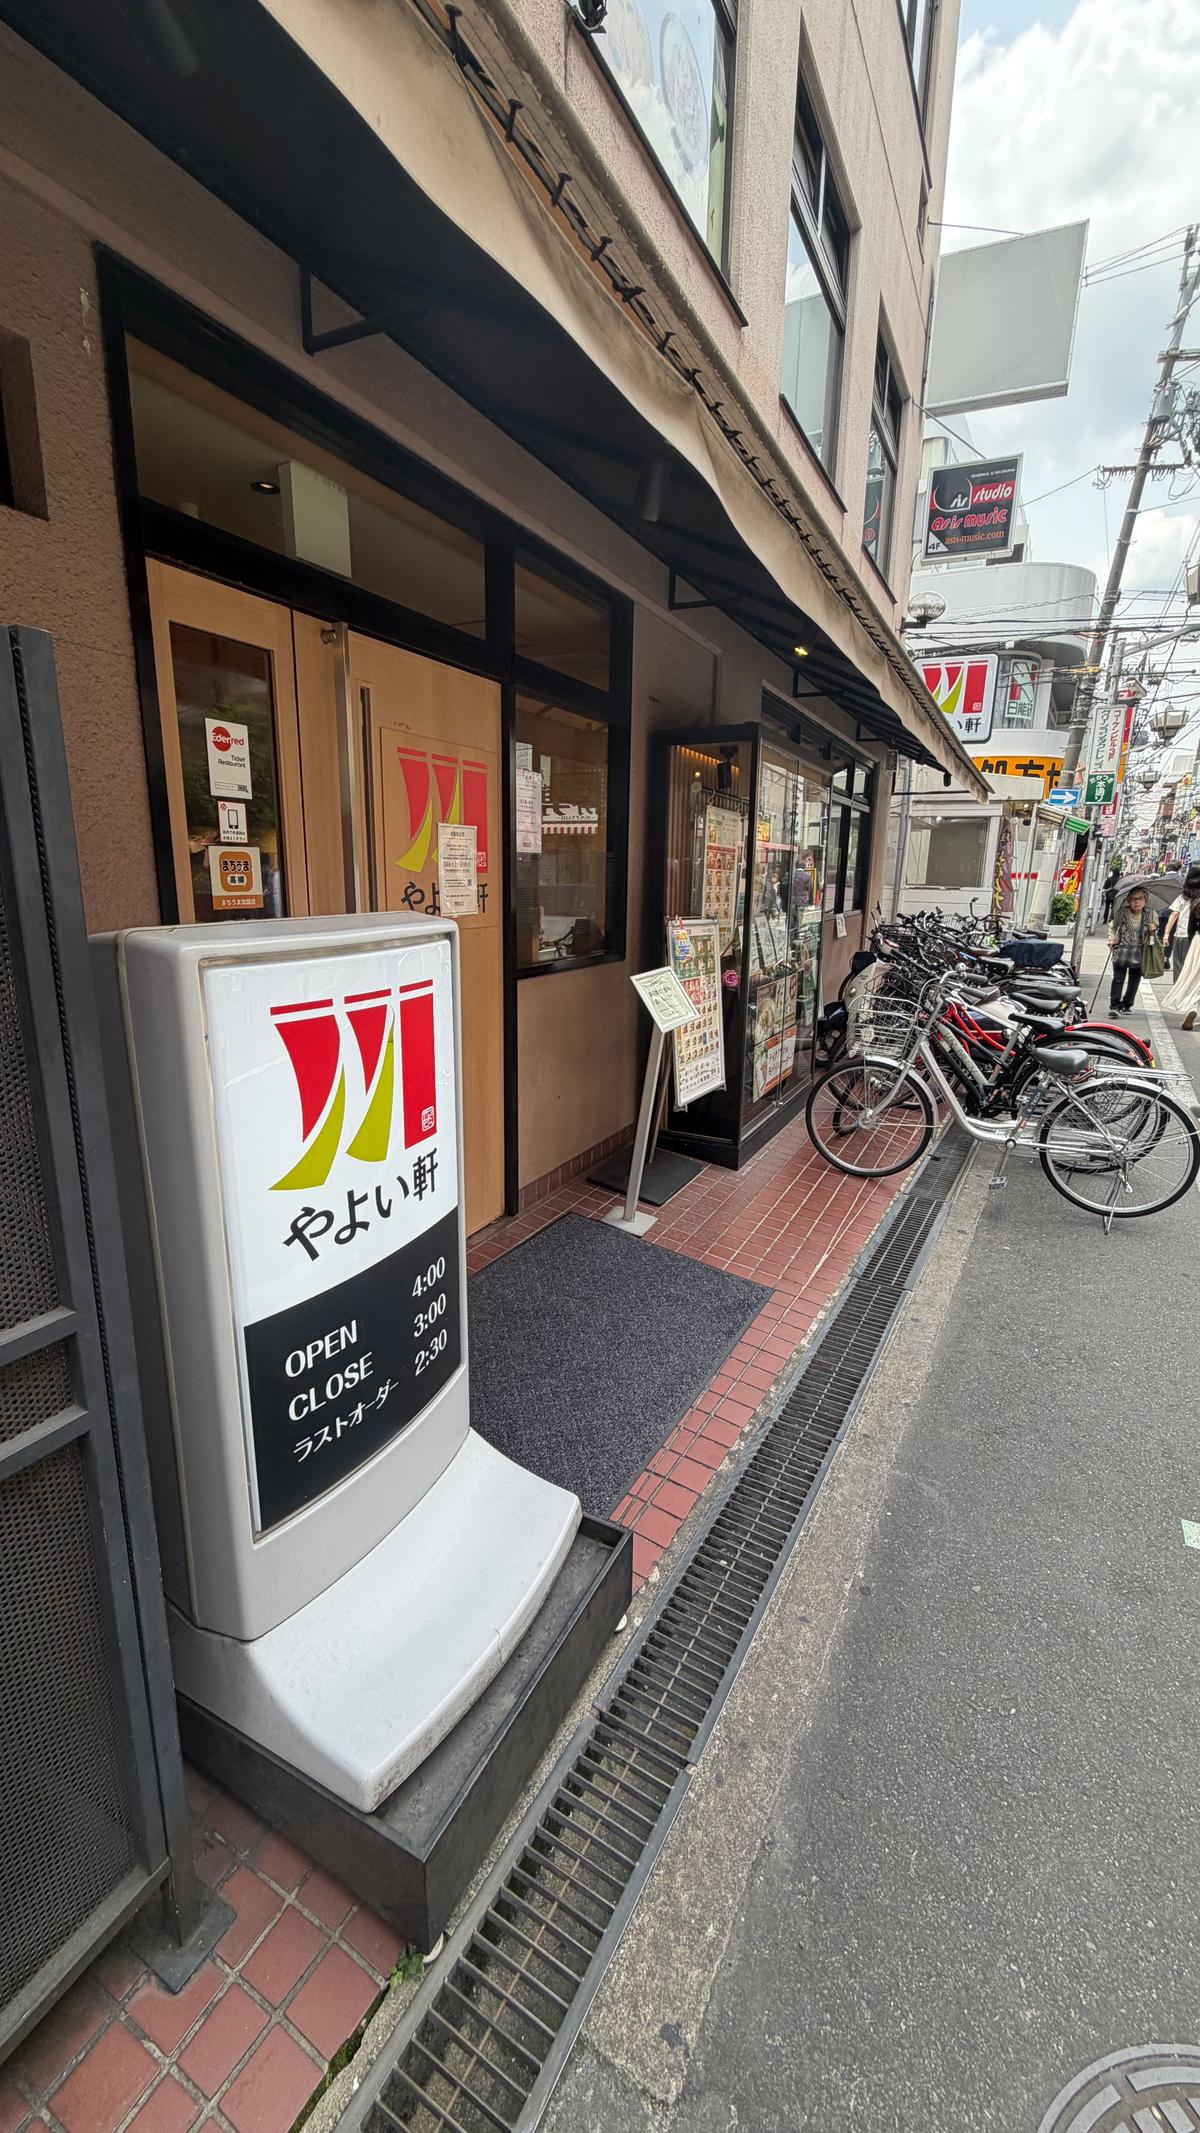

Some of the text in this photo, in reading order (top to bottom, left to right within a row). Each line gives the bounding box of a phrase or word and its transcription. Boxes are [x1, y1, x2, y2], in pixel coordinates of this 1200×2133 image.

[963, 506, 1008, 528] music
[972, 483, 1012, 503] studio
[928, 542, 941, 551] 4F
[211, 731, 245, 746] Edenred
[283, 1147, 439, 1261] やよい軒
[285, 1256, 446, 1379] OPEN 4:00
[288, 1292, 447, 1422] CLOSE 3:00
[293, 1328, 449, 1463] ラストオーダー 2:30
